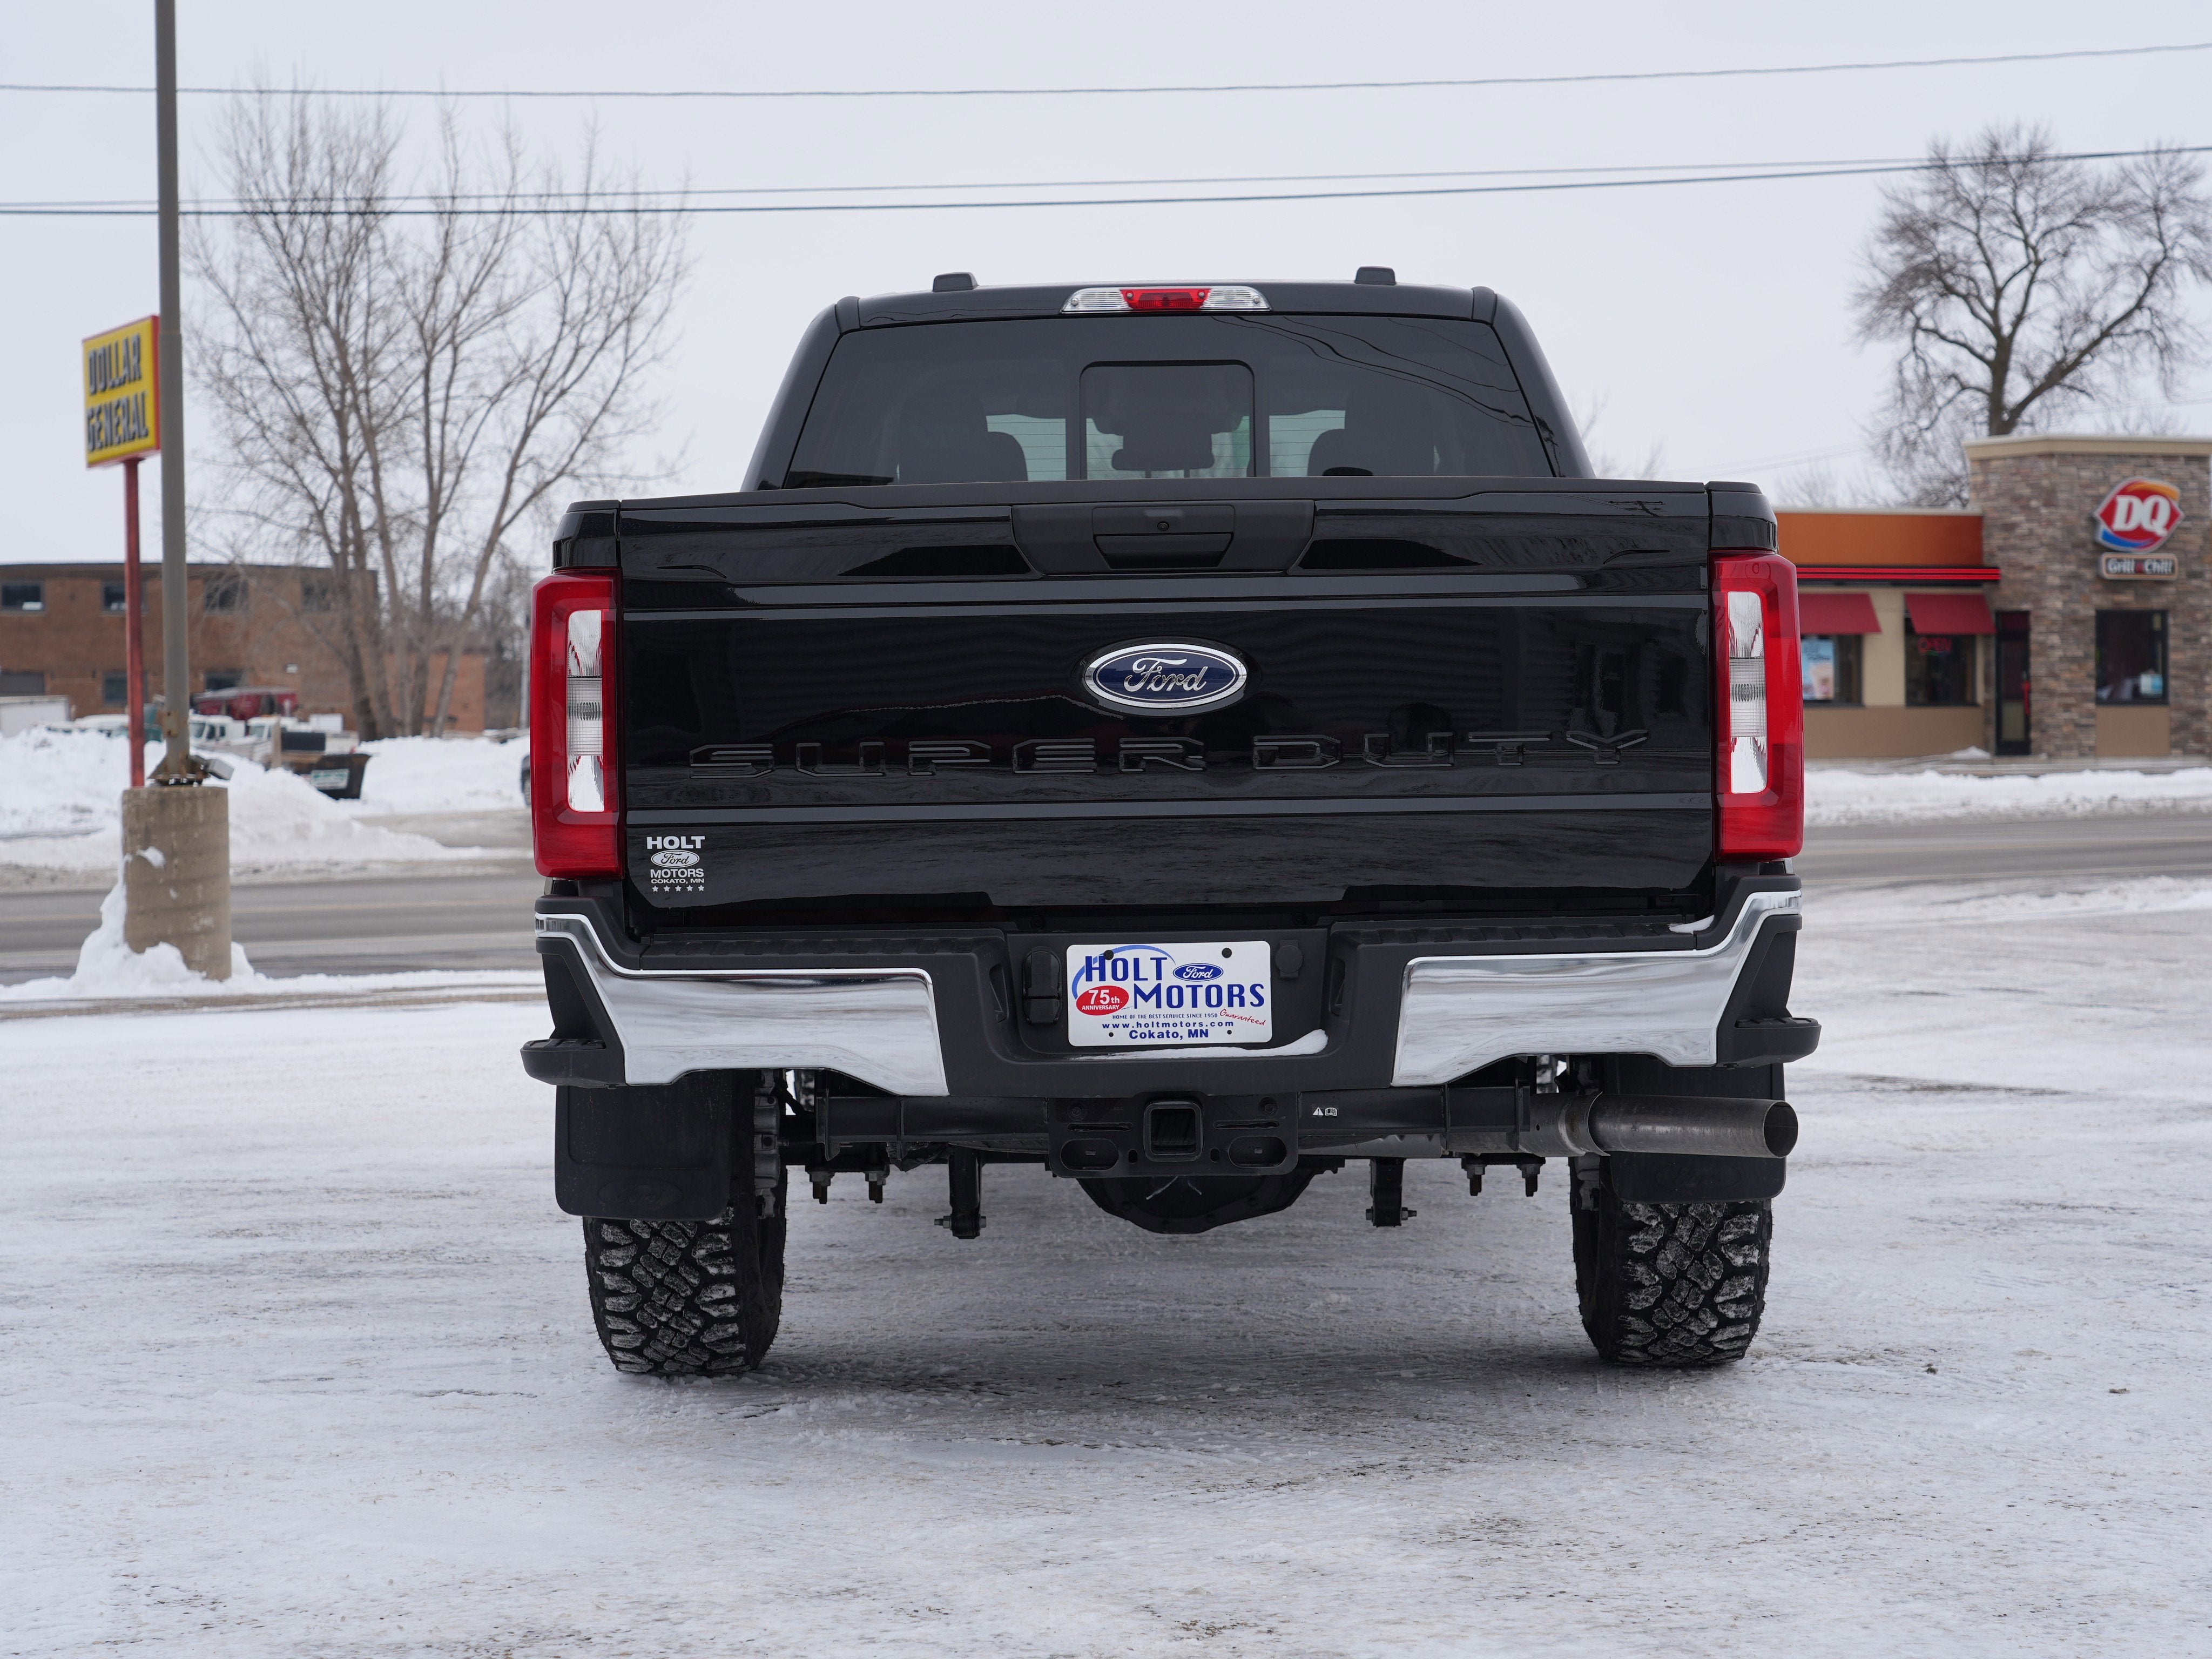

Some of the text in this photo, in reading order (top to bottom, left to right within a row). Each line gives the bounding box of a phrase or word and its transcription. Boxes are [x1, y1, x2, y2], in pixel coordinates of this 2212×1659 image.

[88, 333, 141, 396] DOLLAR
[87, 390, 149, 453] GENERAL
[2112, 494, 2170, 537] DQ
[2108, 558, 2135, 574] Grill
[2144, 558, 2173, 574] Chill
[1123, 657, 1209, 692] Ford
[689, 729, 1650, 779] SUPER DUTY
[647, 836, 705, 849] HOLT
[660, 852, 690, 865] Ford
[650, 868, 704, 879] MOTORS
[1085, 956, 1214, 982] HOLT Ford
[1134, 982, 1265, 1009] MOTORS
[1102, 1021, 1233, 1029] www.holtmotors.com
[1219, 1009, 1266, 1026] Guaranteed
[1129, 1029, 1209, 1041] Cokato, MN
